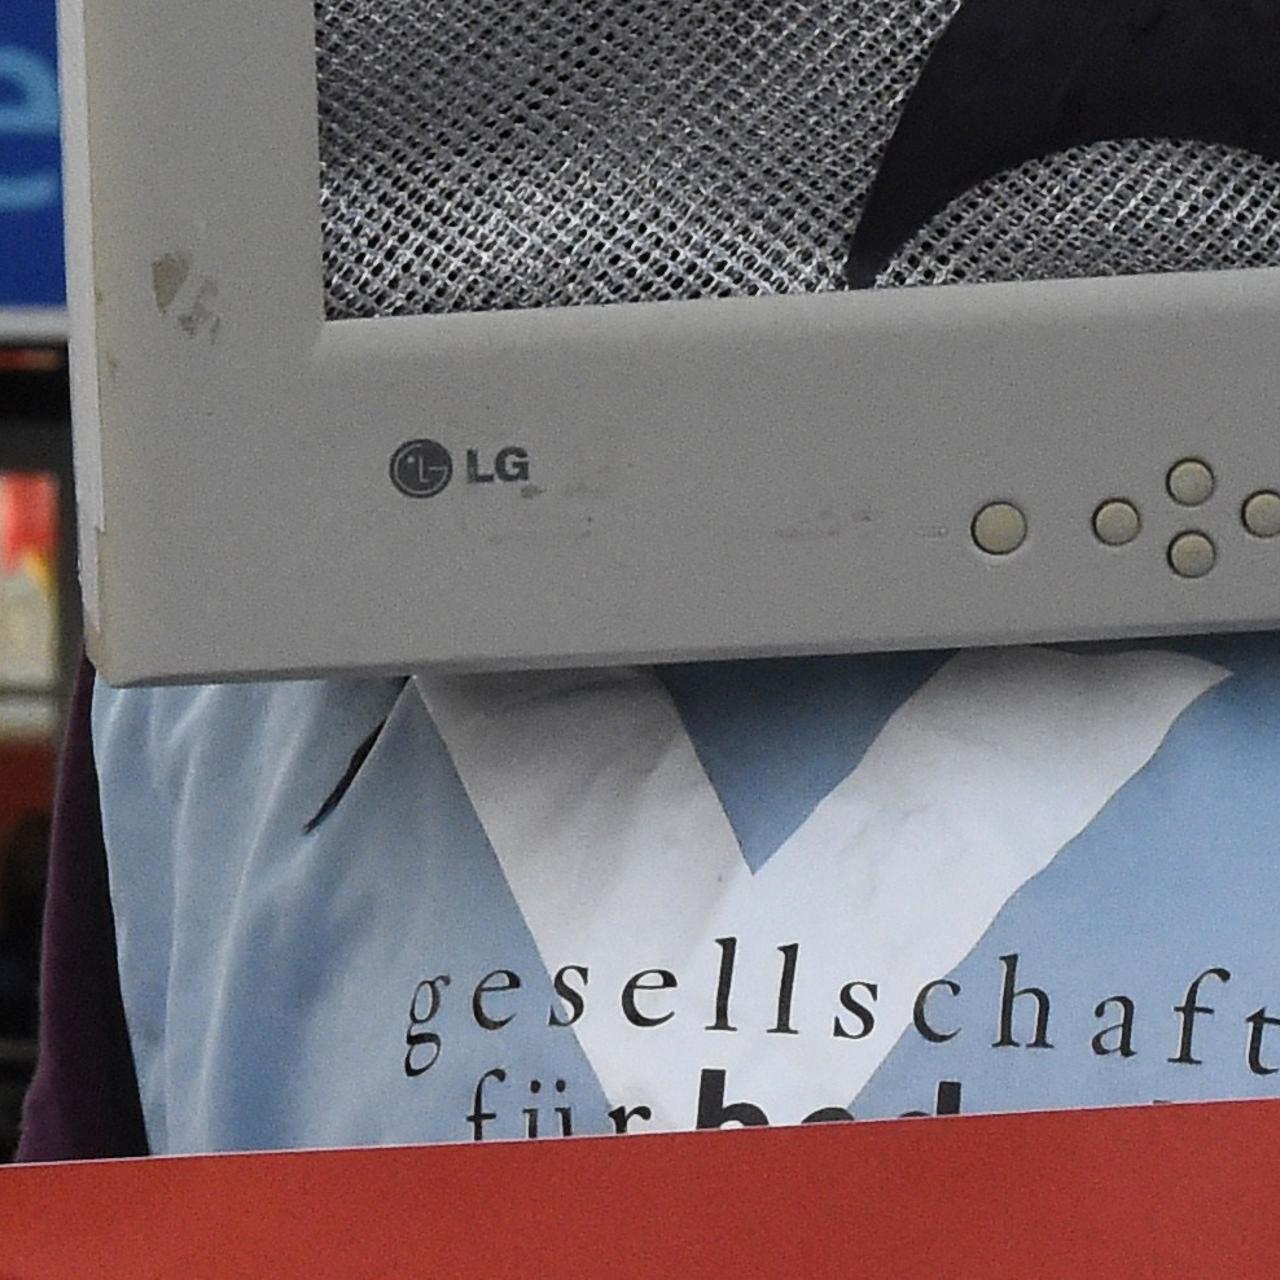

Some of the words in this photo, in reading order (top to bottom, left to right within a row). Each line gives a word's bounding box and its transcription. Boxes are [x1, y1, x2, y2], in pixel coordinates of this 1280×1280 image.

[466, 446, 530, 484] LG
[403, 936, 1280, 1078] gesellschaft
[465, 1067, 652, 1142] für
